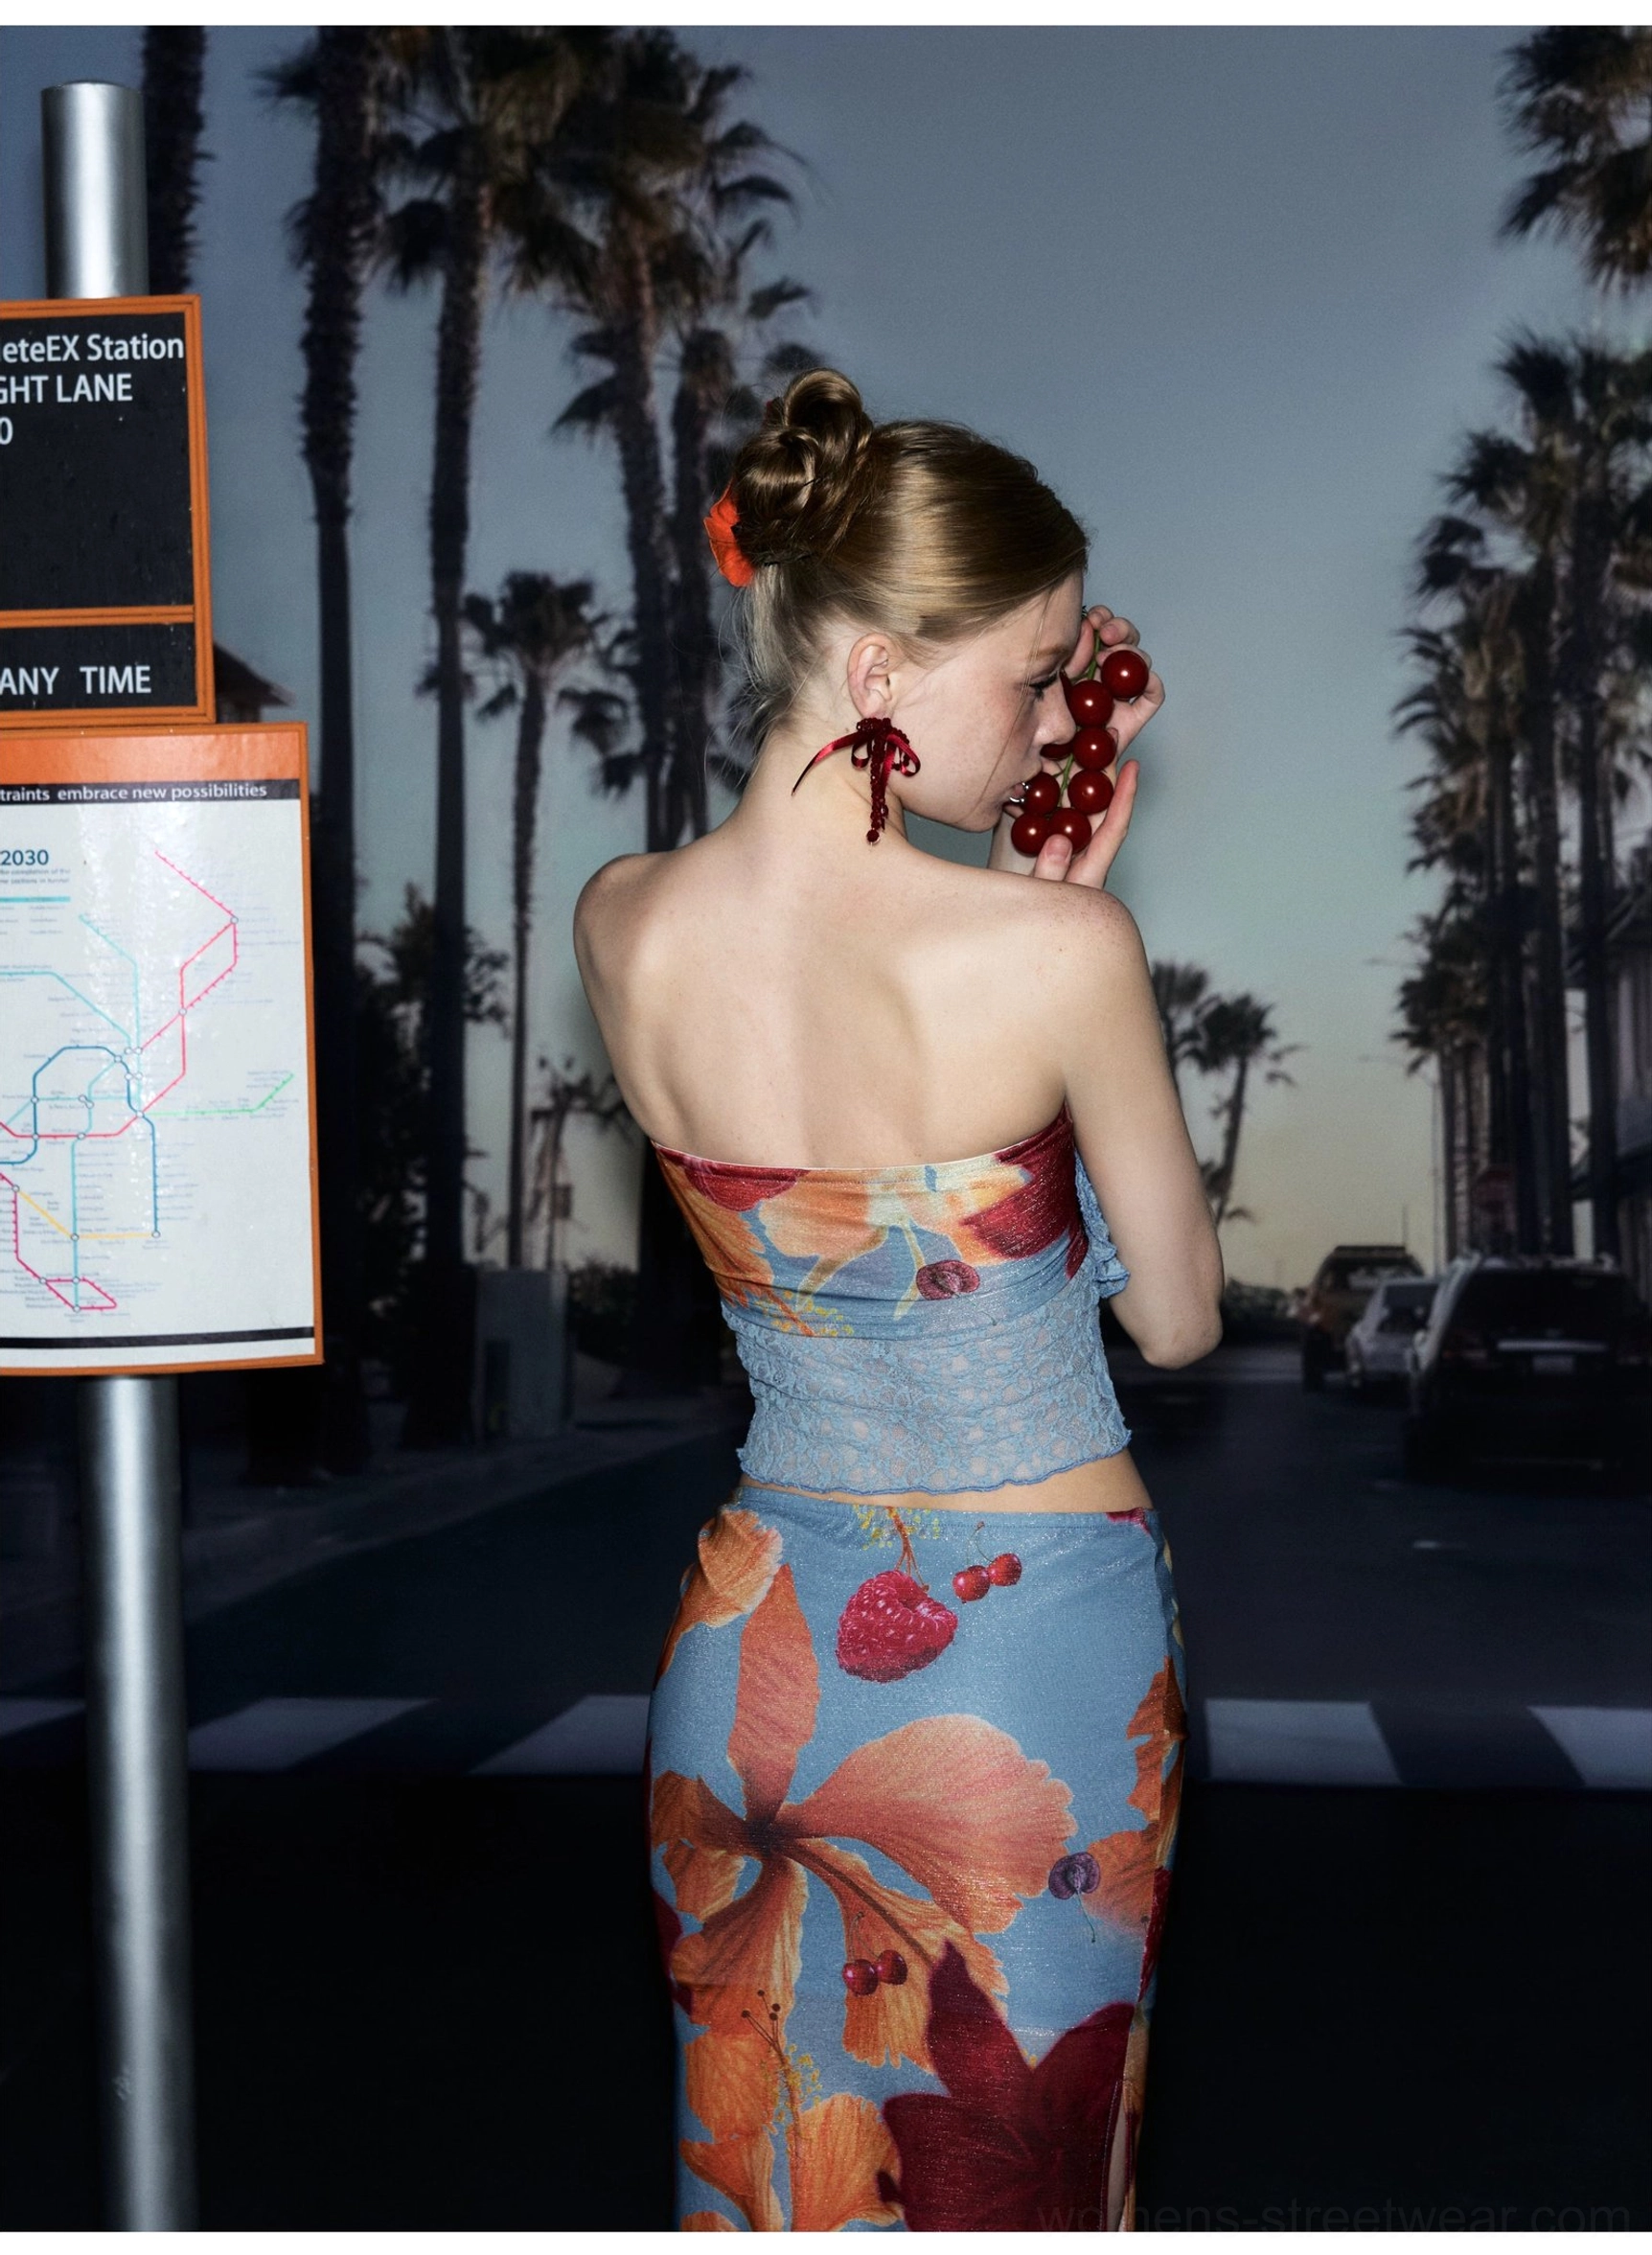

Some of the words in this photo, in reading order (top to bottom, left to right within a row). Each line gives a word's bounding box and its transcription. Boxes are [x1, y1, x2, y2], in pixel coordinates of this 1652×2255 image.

[0, 335, 80, 362] eteEX
[87, 334, 184, 361] Station
[56, 374, 133, 403] LANE
[0, 666, 59, 695] ANY
[80, 666, 152, 695] TIME
[0, 787, 50, 802] traints
[57, 786, 128, 801] embrace
[132, 788, 167, 800] new
[171, 783, 267, 801] possibilities
[0, 849, 49, 865] 2030
